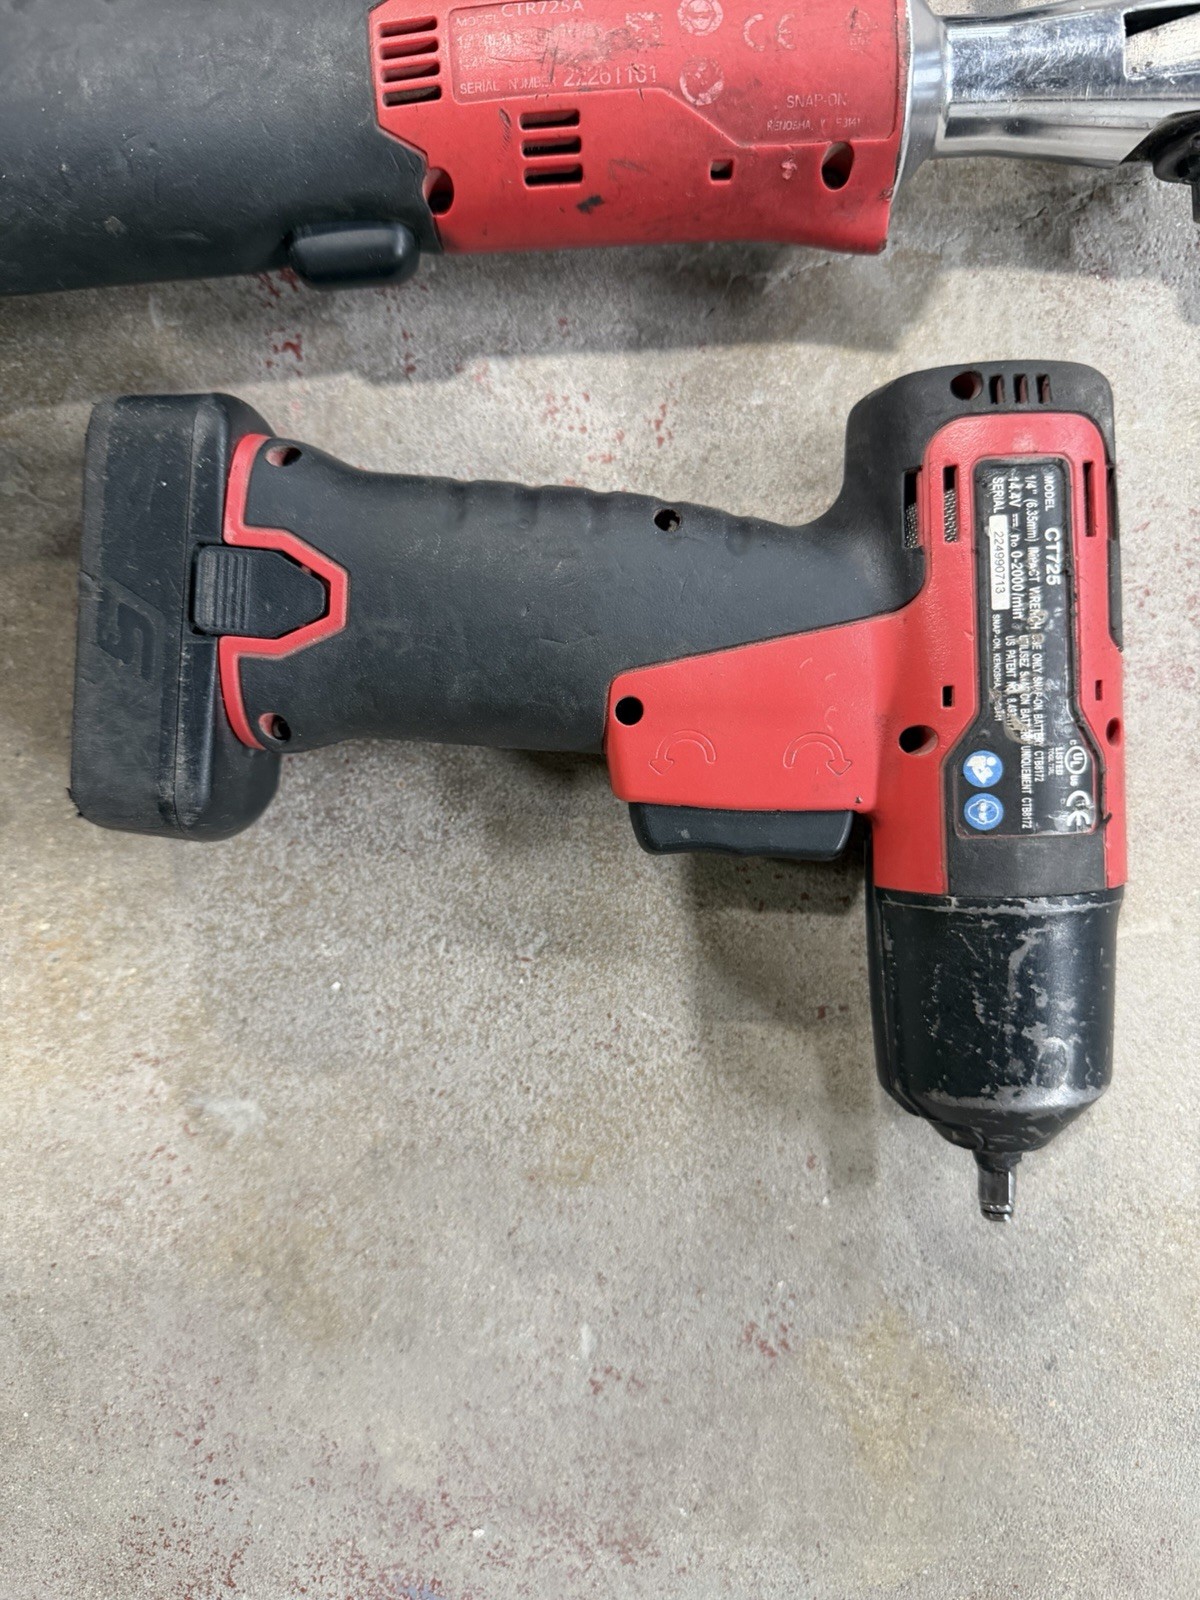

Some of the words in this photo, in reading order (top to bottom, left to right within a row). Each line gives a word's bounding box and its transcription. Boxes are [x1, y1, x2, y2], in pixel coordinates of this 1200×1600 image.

[502, 0, 584, 17] CTR725A
[460, 81, 500, 94] SERIAL
[992, 477, 1004, 513] SERIAL
[1008, 476, 1021, 507] 14.4V
[1025, 475, 1037, 494] 1/4"
[1045, 475, 1055, 511] MODEL
[1024, 499, 1039, 542] (6.35mm)
[994, 532, 1005, 594] 224990713
[1028, 547, 1040, 582] IMPACT
[1045, 527, 1061, 585] CT725
[1029, 587, 1041, 629] WRENCH
[1005, 636, 1015, 646] US
[1006, 650, 1016, 678] PATENT
[1032, 653, 1042, 673] ONLY
[1034, 714, 1044, 747] BATTERY
[1021, 746, 1032, 794] UNIQUEMENT
[1034, 751, 1044, 782] CTB8172
[1055, 747, 1063, 775] LISTED
[1022, 798, 1032, 828] CTB8172
